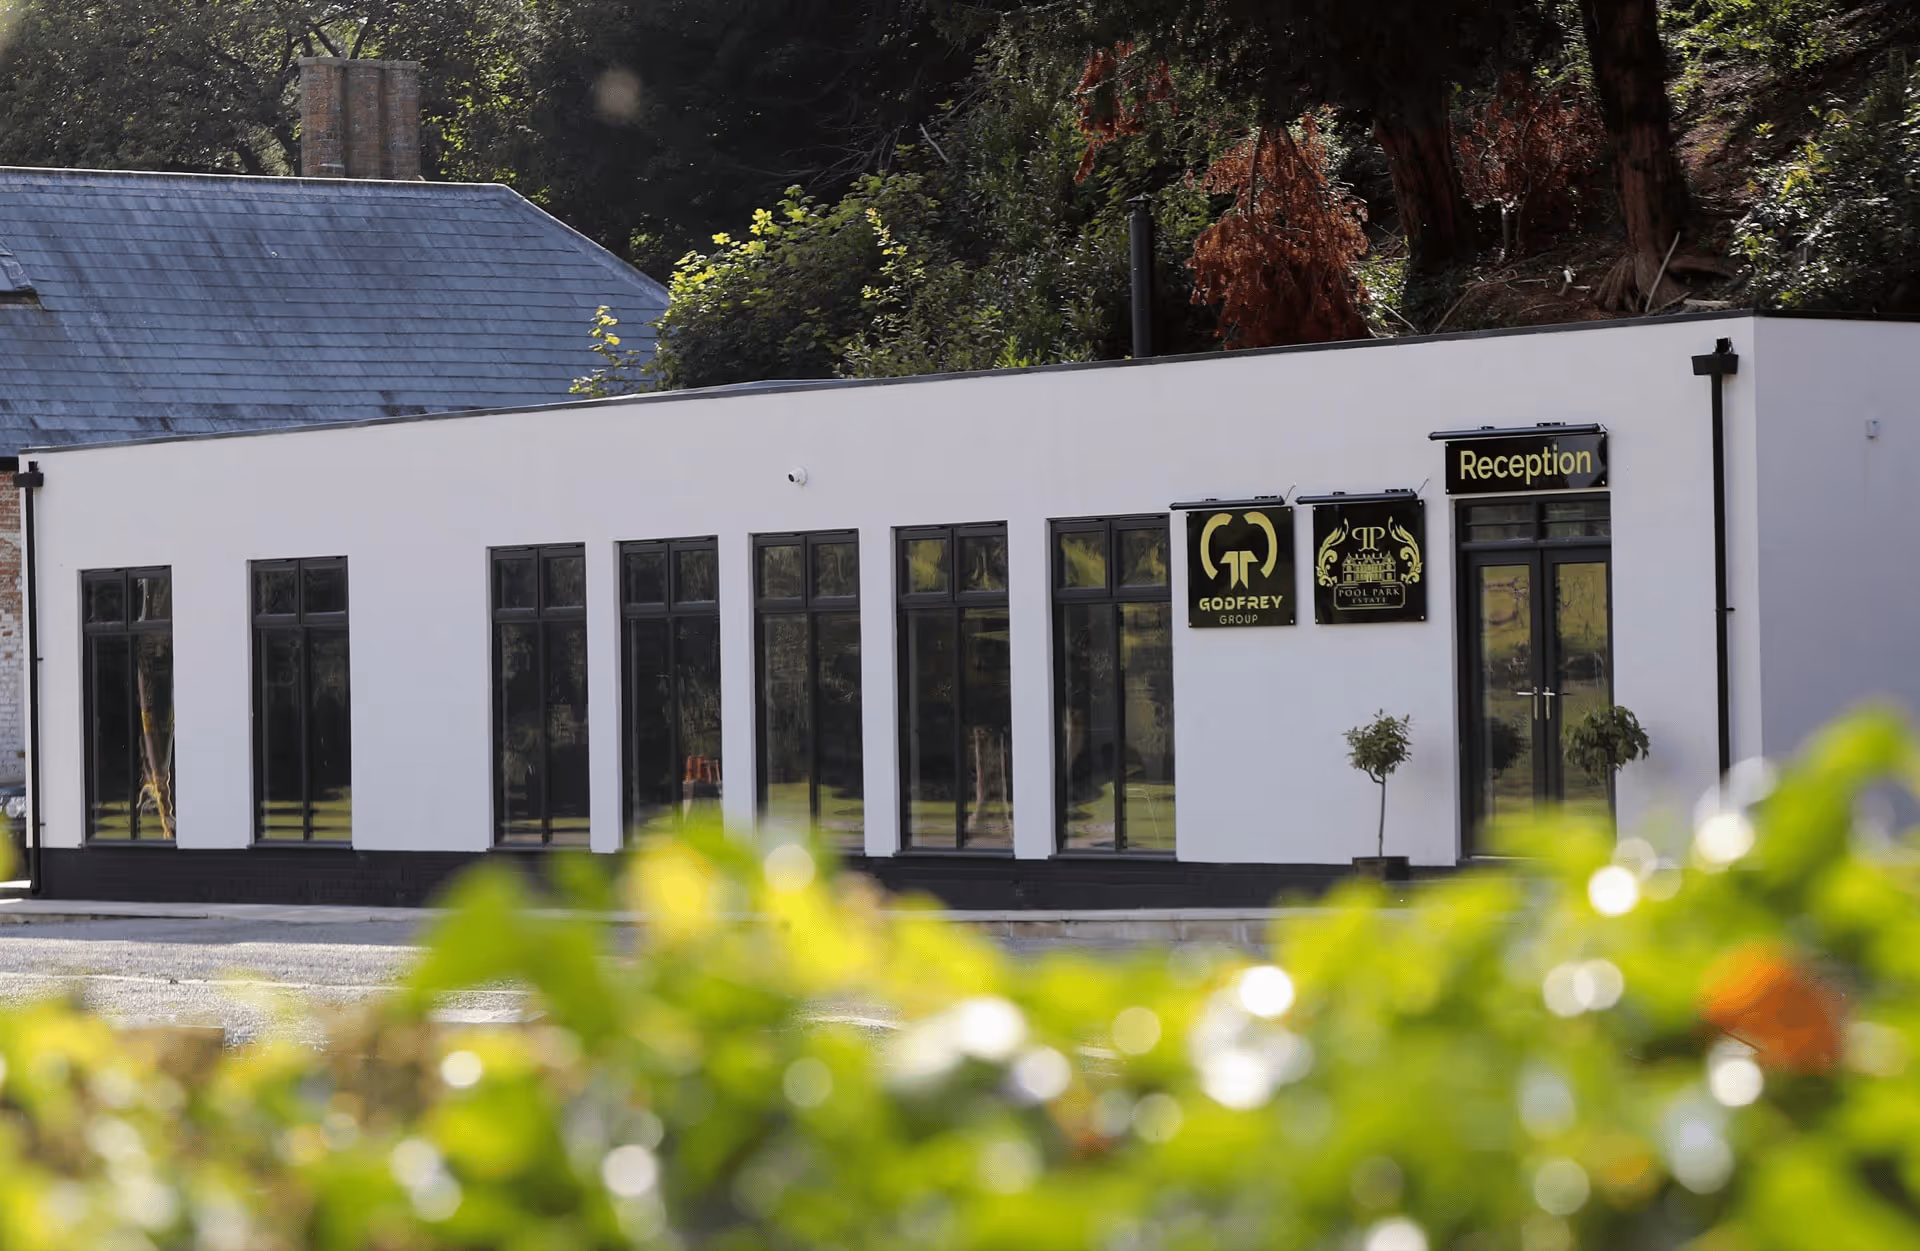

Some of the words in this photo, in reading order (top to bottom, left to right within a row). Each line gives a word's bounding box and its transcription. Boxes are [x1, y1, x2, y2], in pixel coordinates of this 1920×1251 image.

[1460, 444, 1592, 485] Reception
[1338, 588, 1367, 598] POOL
[1372, 587, 1400, 597] PARK
[1199, 595, 1283, 612] GODFREY
[1219, 614, 1258, 625] GROUP
